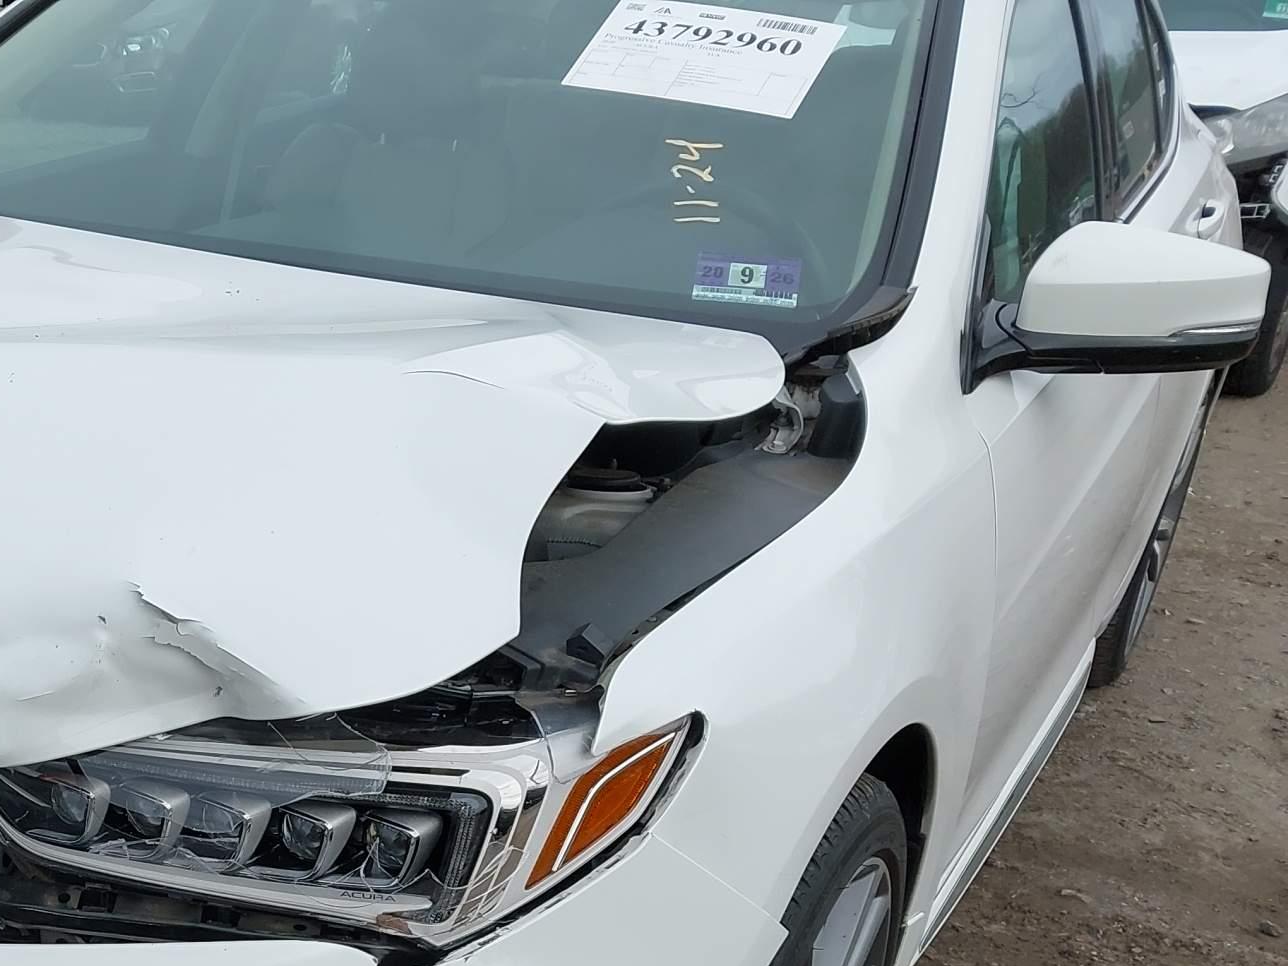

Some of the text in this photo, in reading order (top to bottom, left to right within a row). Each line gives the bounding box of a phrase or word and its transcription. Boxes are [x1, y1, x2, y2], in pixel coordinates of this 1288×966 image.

[624, 18, 803, 57] 43792960
[740, 266, 755, 284] 9
[340, 890, 396, 902] ACURA
